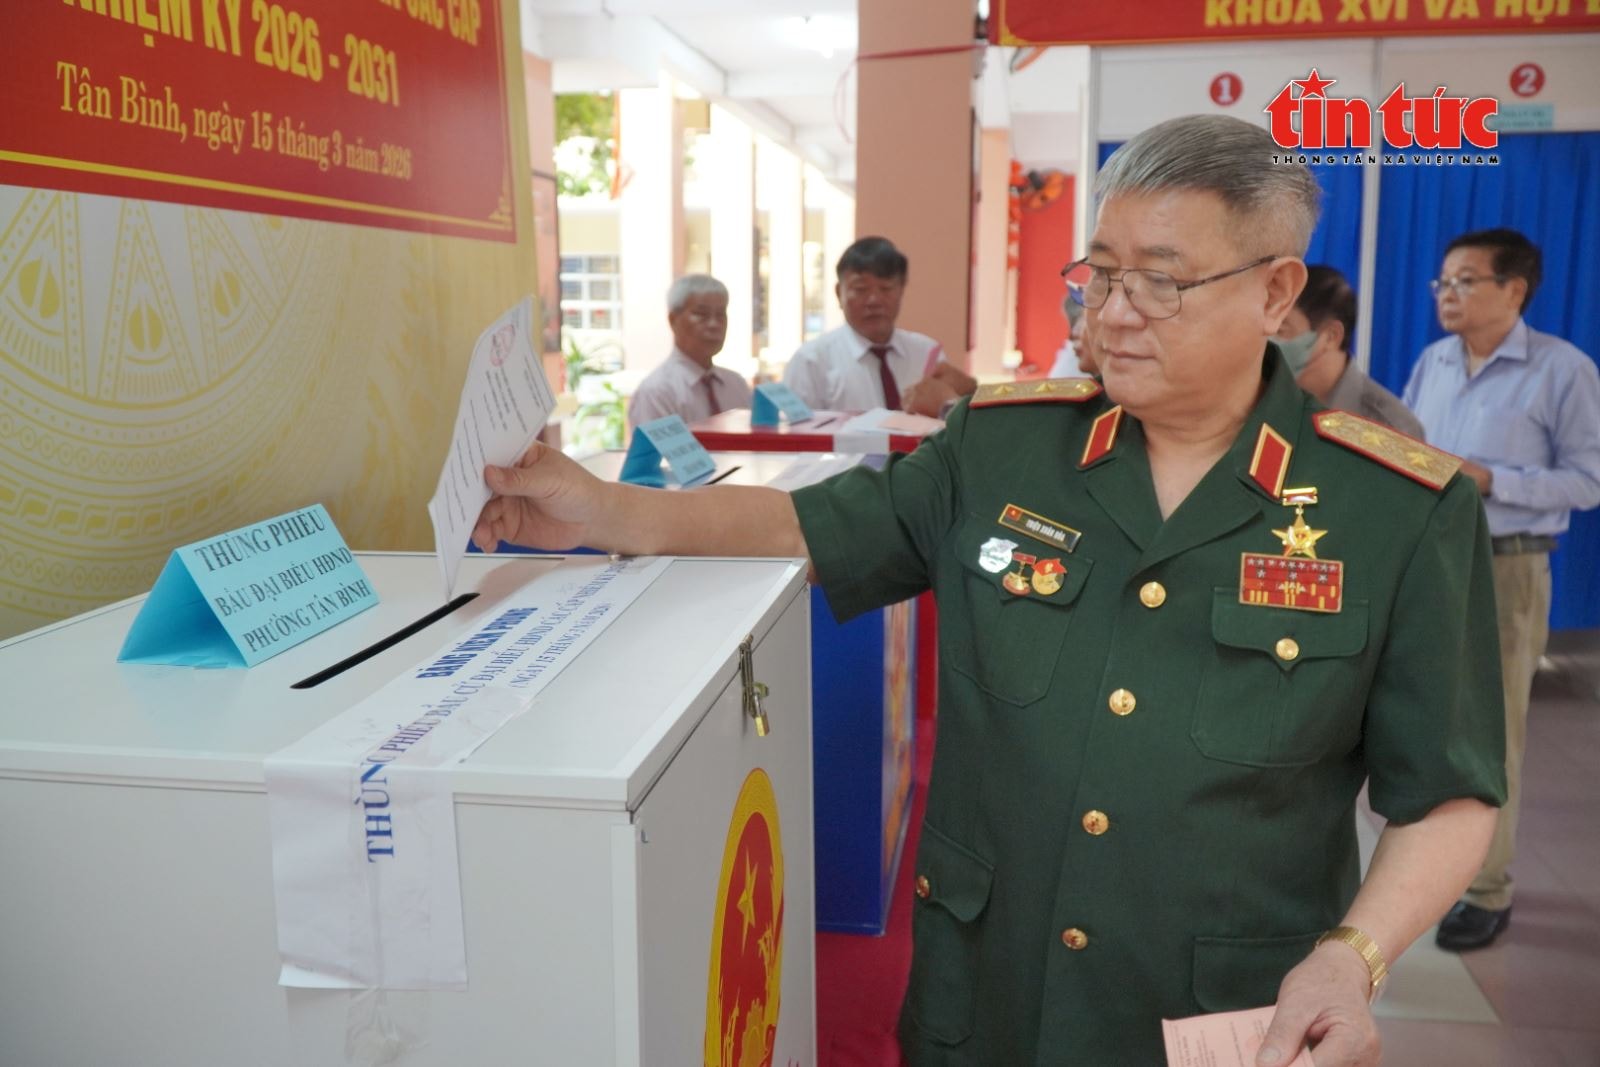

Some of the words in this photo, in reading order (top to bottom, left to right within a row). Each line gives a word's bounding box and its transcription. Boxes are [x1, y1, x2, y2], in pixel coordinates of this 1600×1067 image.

[252, 0, 323, 82] 2026
[328, 54, 340, 69] -
[345, 33, 399, 107] 2031
[57, 61, 112, 119] Tân
[120, 76, 188, 143] Bình,
[193, 101, 246, 154] ngày
[251, 110, 273, 151] 15
[277, 116, 330, 172] tháng
[332, 130, 343, 166] 3
[381, 143, 412, 180] 2026
[194, 528, 272, 572] THÙNG
[249, 575, 283, 602] ĐẠI
[312, 546, 353, 575] HĐND
[243, 608, 312, 652] PHƯỜNG
[305, 594, 340, 621] TÂN
[334, 578, 372, 607] BÌNH
[354, 755, 397, 863] THÙNG
